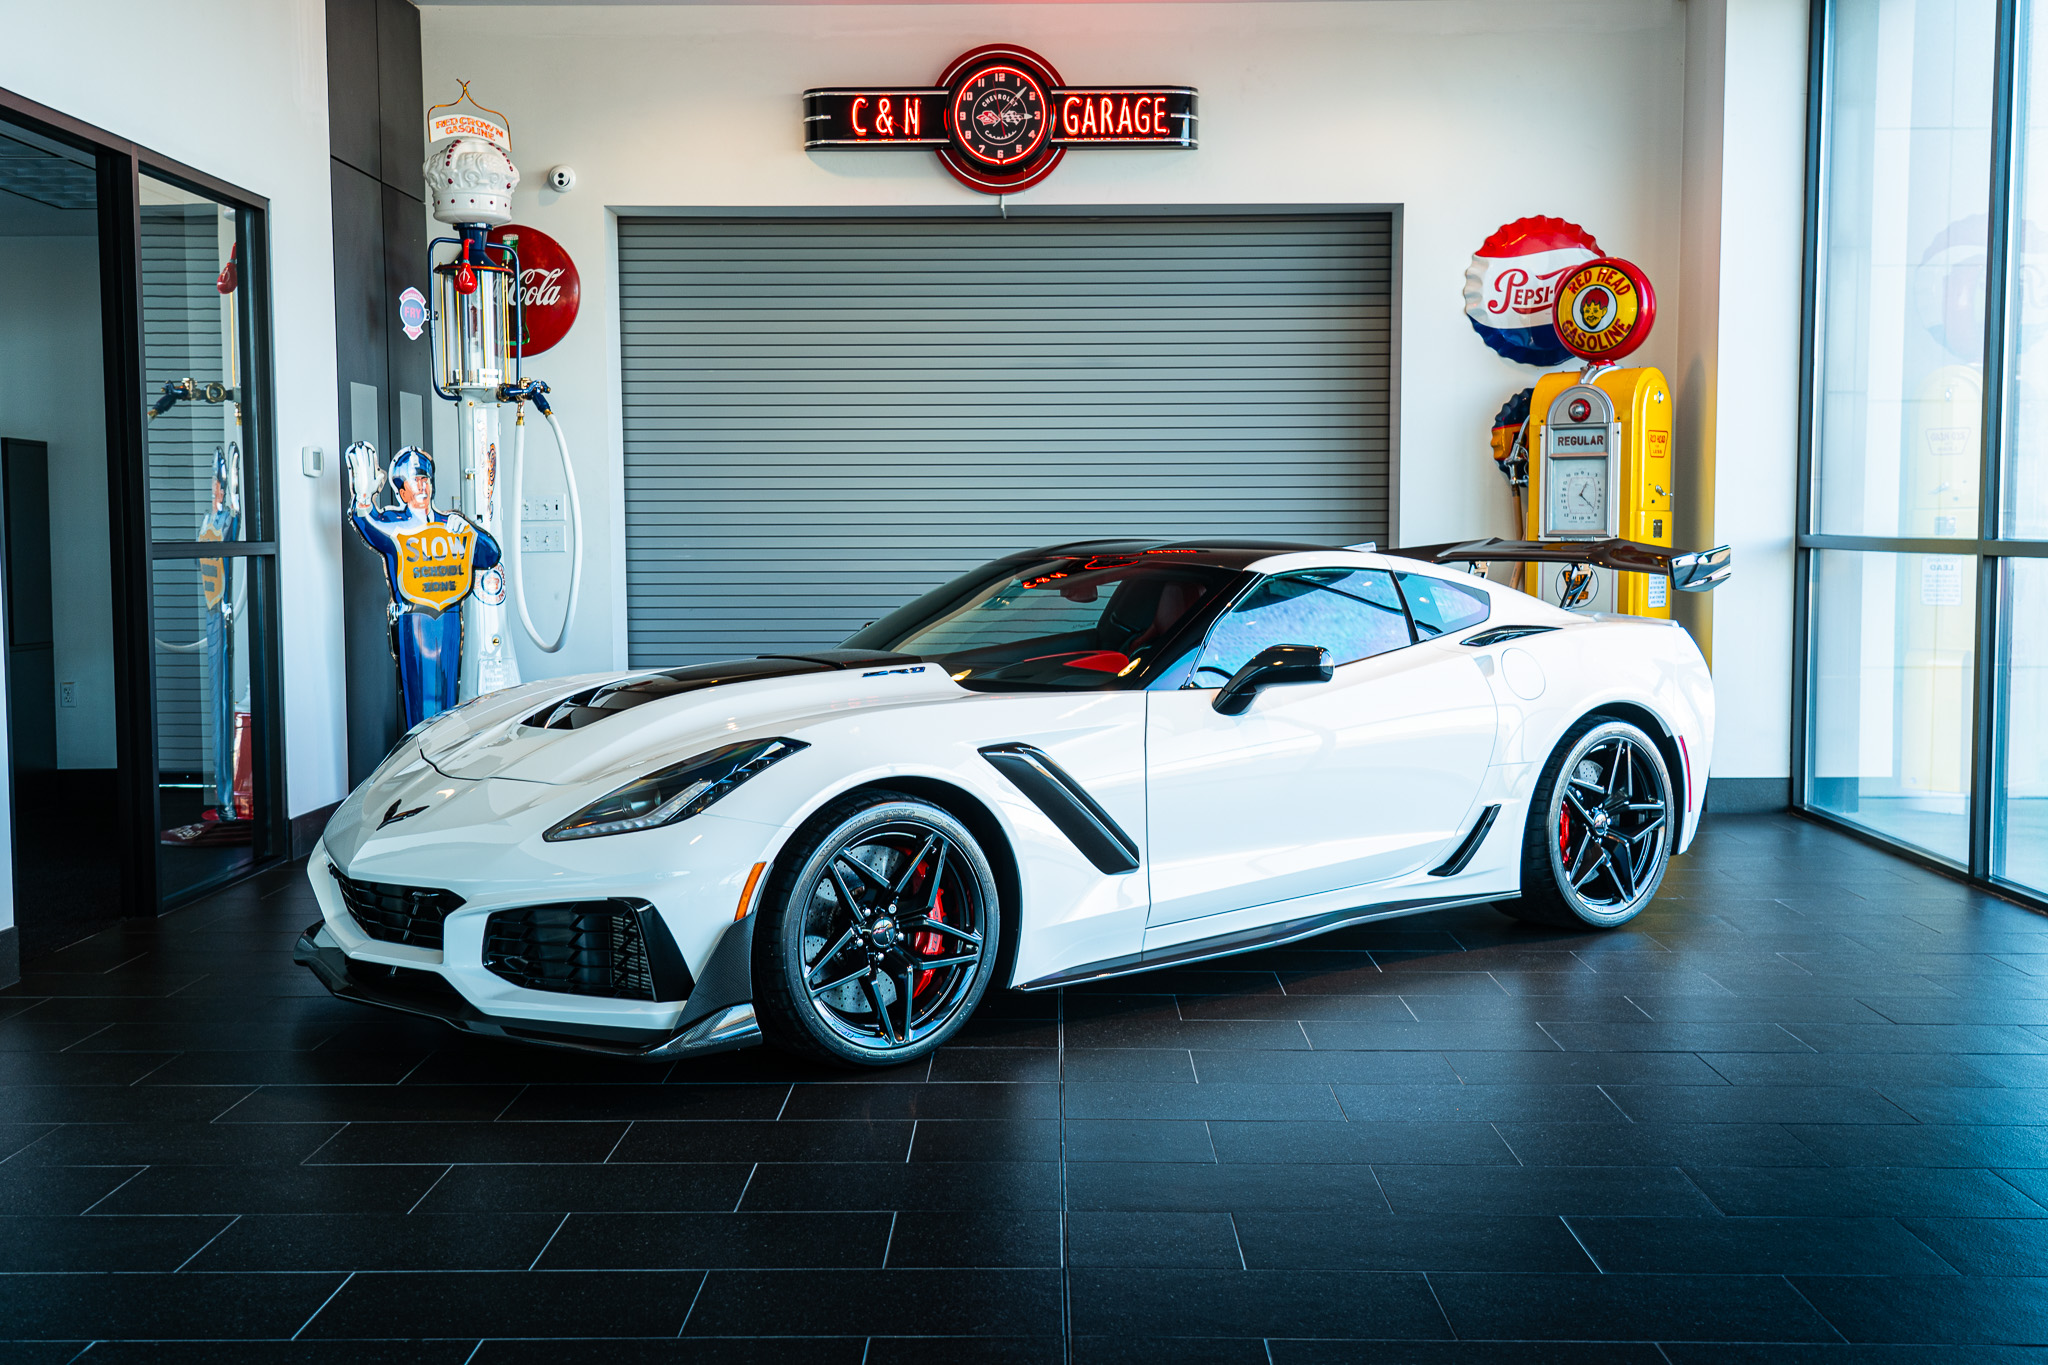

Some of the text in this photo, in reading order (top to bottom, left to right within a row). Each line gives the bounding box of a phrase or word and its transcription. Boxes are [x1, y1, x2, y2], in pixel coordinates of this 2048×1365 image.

[978, 78, 985, 88] 11
[995, 73, 1006, 82] 12
[1017, 78, 1020, 86] 1
[963, 92, 973, 100] 10
[982, 94, 1018, 108] CHEVROLET
[1029, 92, 1036, 100] 2
[852, 97, 920, 136] C & N
[960, 112, 966, 120] 9
[1034, 111, 1040, 120] 3
[1064, 96, 1168, 136] GARAGE
[436, 117, 504, 138] RED CROWN
[446, 124, 496, 142] GASOLINE
[965, 130, 972, 140] 8
[1028, 130, 1036, 138] 4
[978, 145, 986, 154] 7
[997, 150, 1004, 158] 6
[1016, 144, 1022, 153] 5
[1566, 267, 1631, 296] RED HEAD
[404, 306, 422, 320] FRY
[1561, 318, 1632, 352] GASOLINE
[1558, 434, 1604, 446] REGULAR
[406, 536, 468, 562] SLOW
[413, 564, 464, 578] SCHOOL
[422, 580, 456, 592] ZONE
